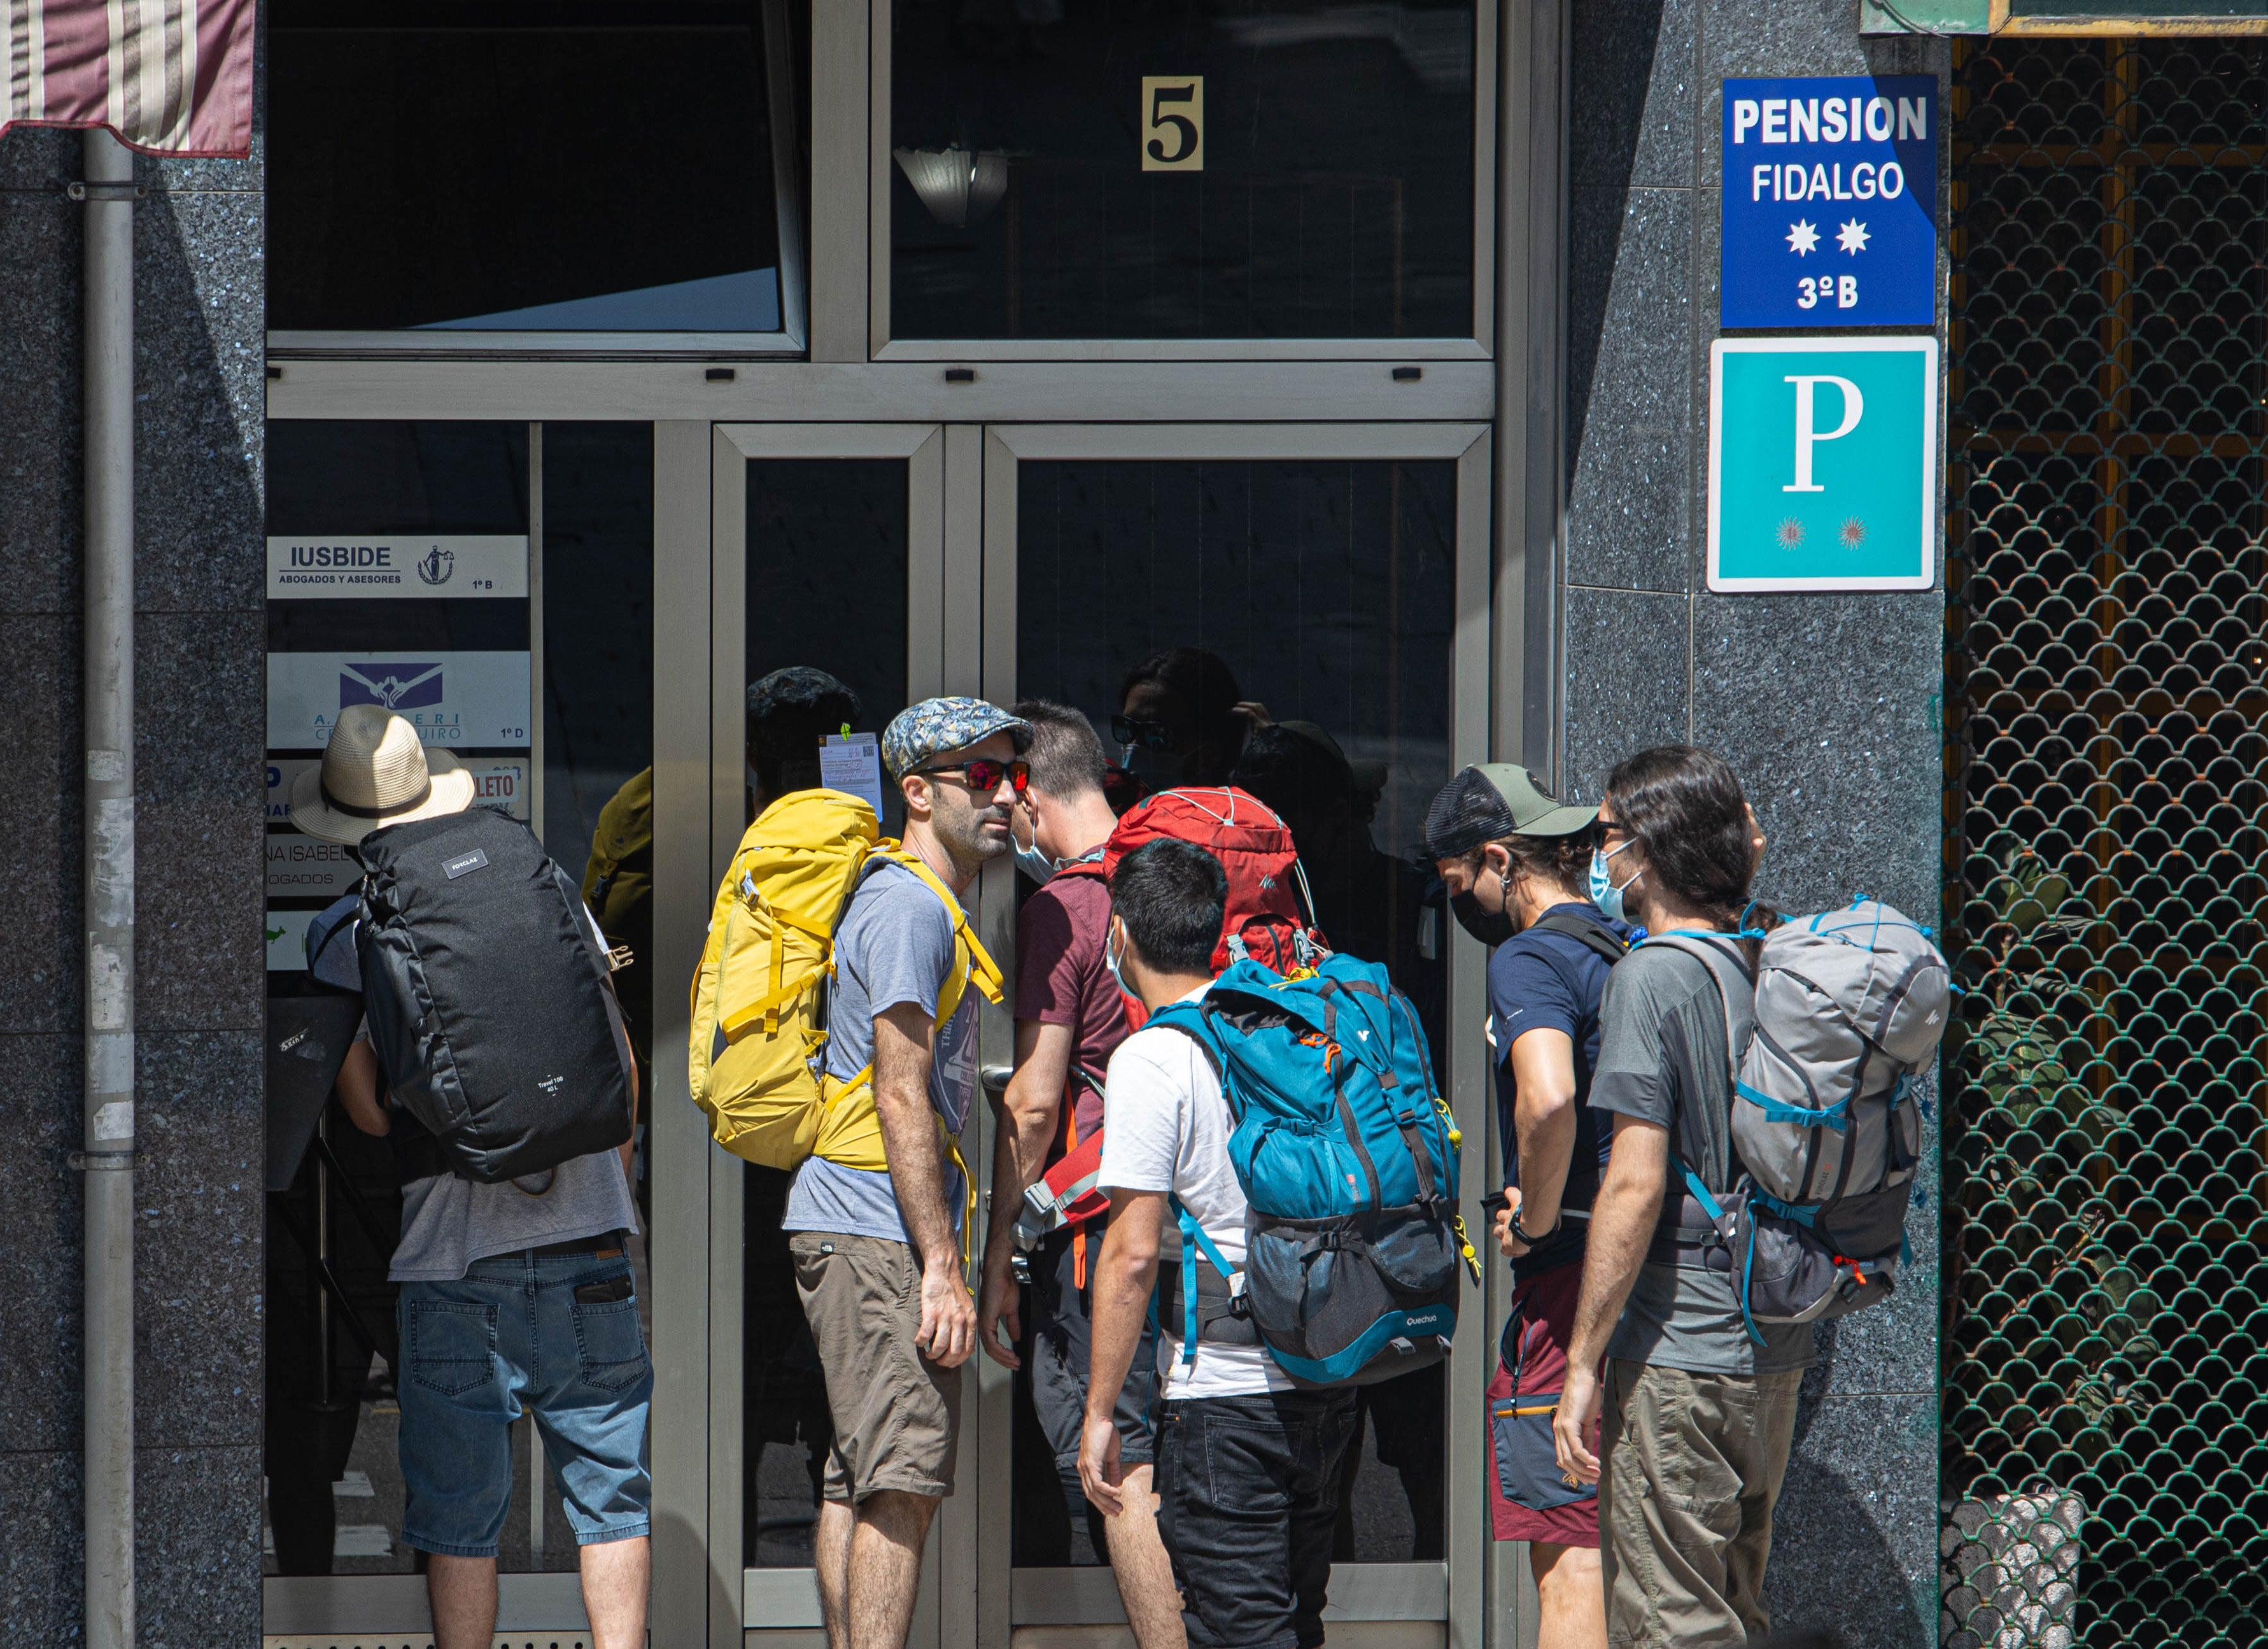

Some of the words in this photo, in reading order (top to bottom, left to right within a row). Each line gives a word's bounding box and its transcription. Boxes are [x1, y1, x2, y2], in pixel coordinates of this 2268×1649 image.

[1146, 83, 1199, 163] 5
[1733, 97, 1927, 144] PENSION
[1752, 162, 1904, 202] FIDALGO
[1782, 375, 1864, 492] P
[291, 546, 391, 567] IUSBIDE
[279, 575, 335, 584] ABOGADOS
[339, 575, 345, 584] Y
[347, 575, 401, 584] ASESORES
[289, 845, 351, 861] ISABEL
[538, 1079, 554, 1089] Travel
[1406, 1315, 1437, 1326] Quechua
